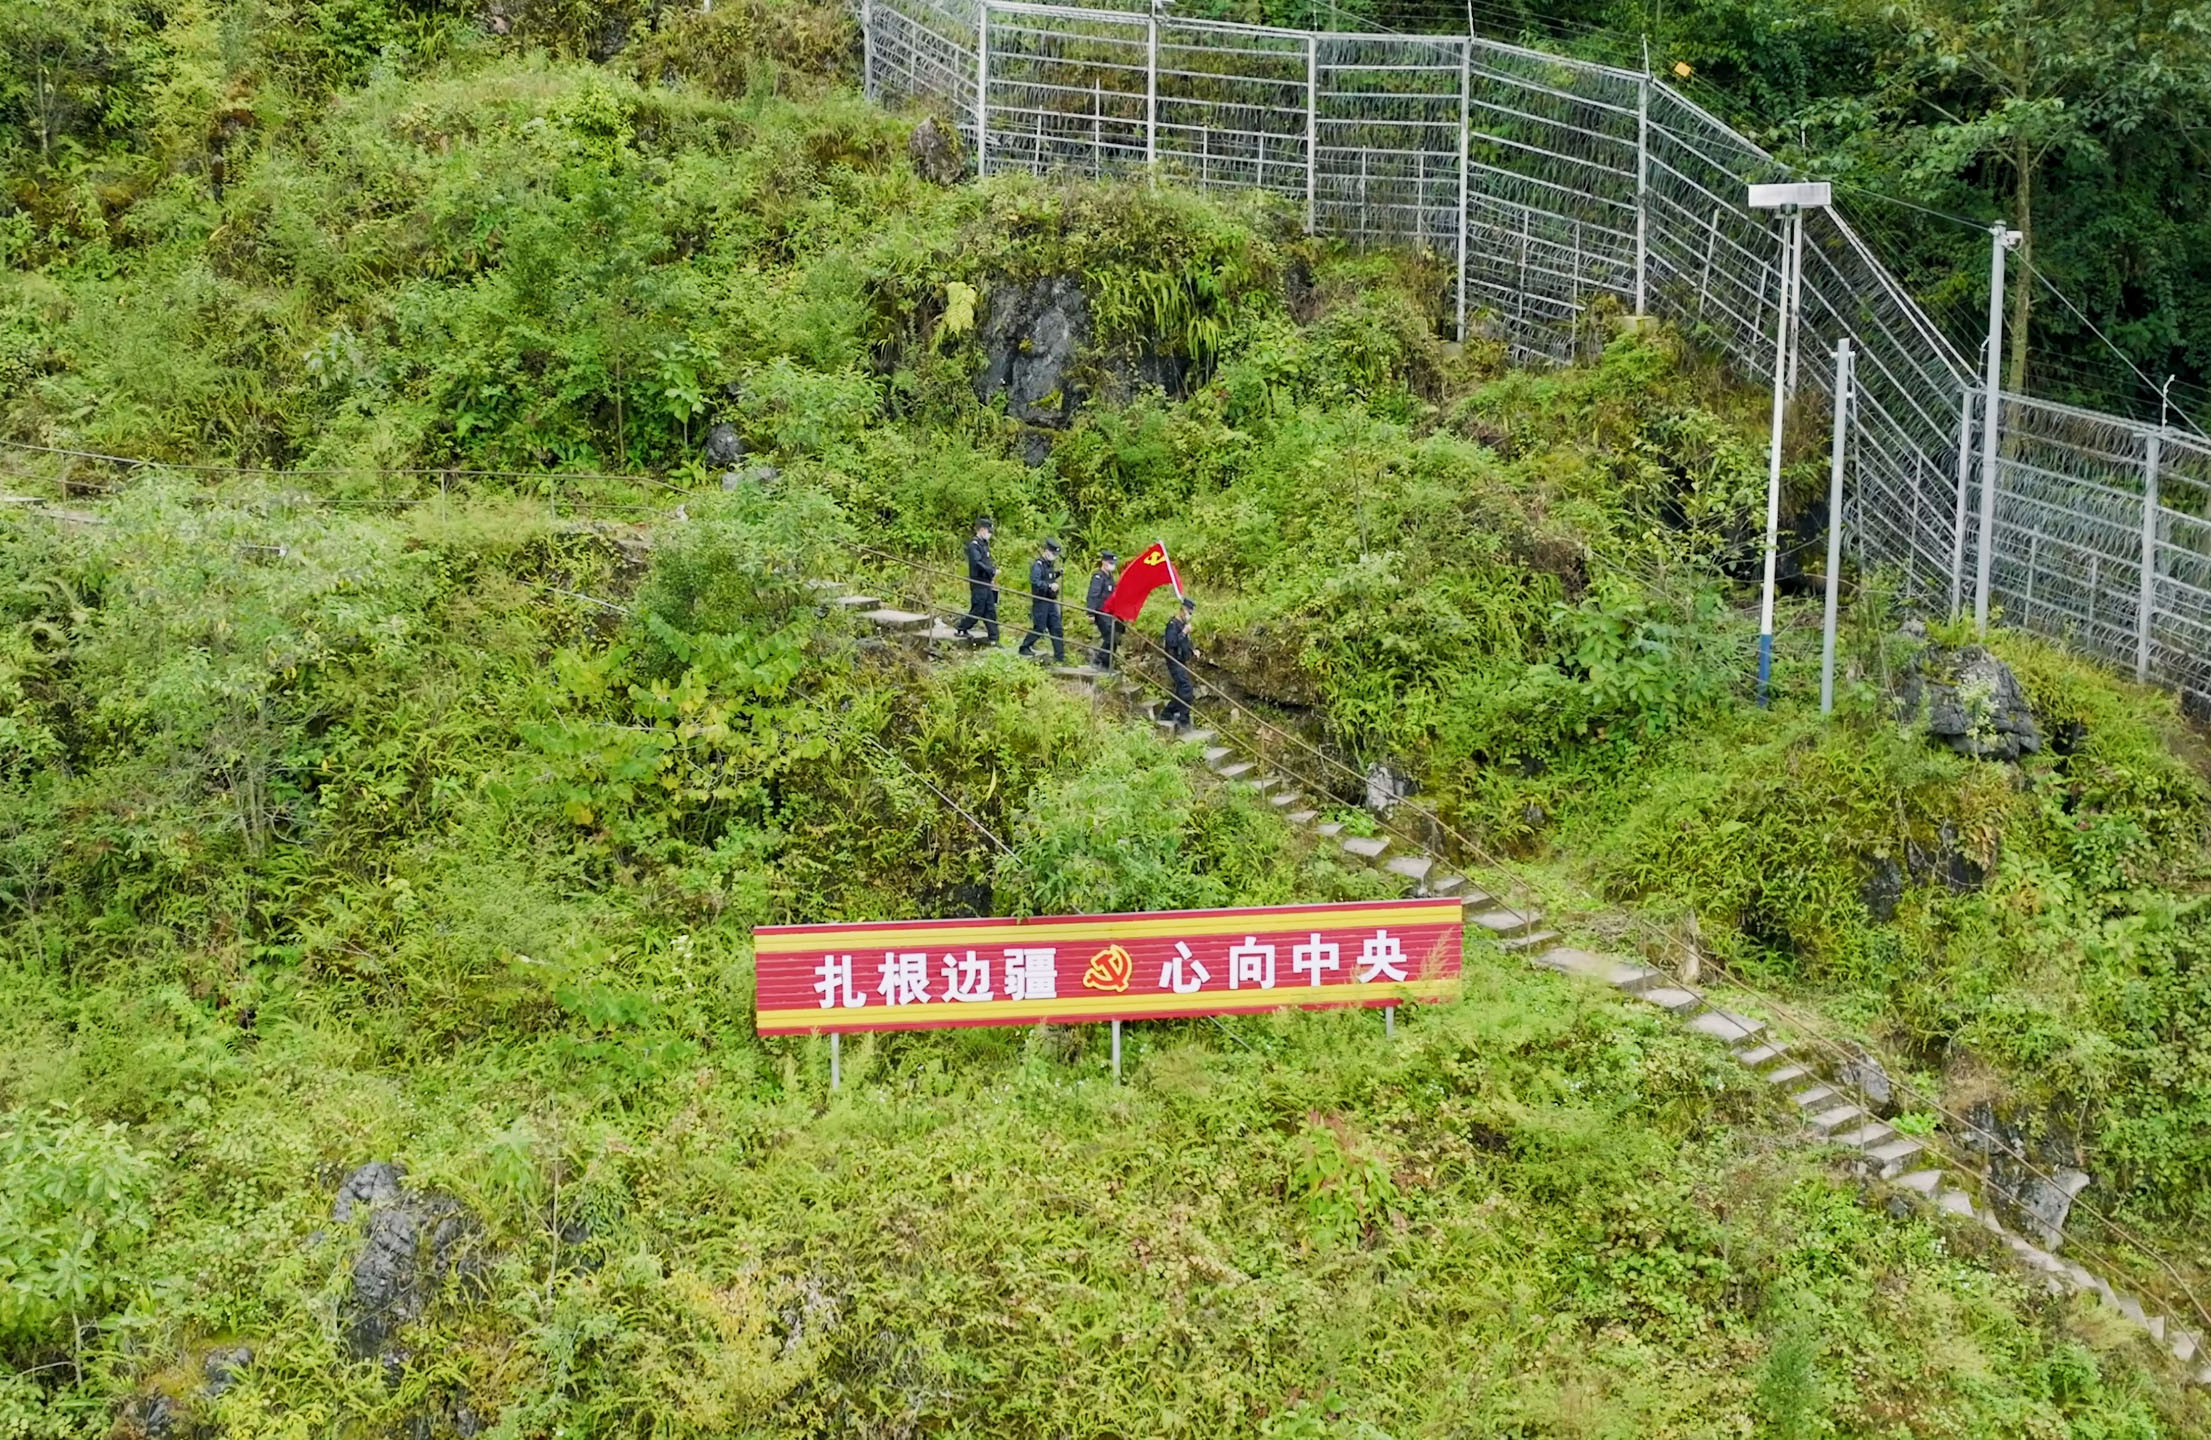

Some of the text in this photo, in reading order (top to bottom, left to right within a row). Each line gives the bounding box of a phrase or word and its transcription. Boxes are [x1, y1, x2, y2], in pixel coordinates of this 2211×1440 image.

[814, 929, 1409, 1008] 扎根边疆 心向中央
